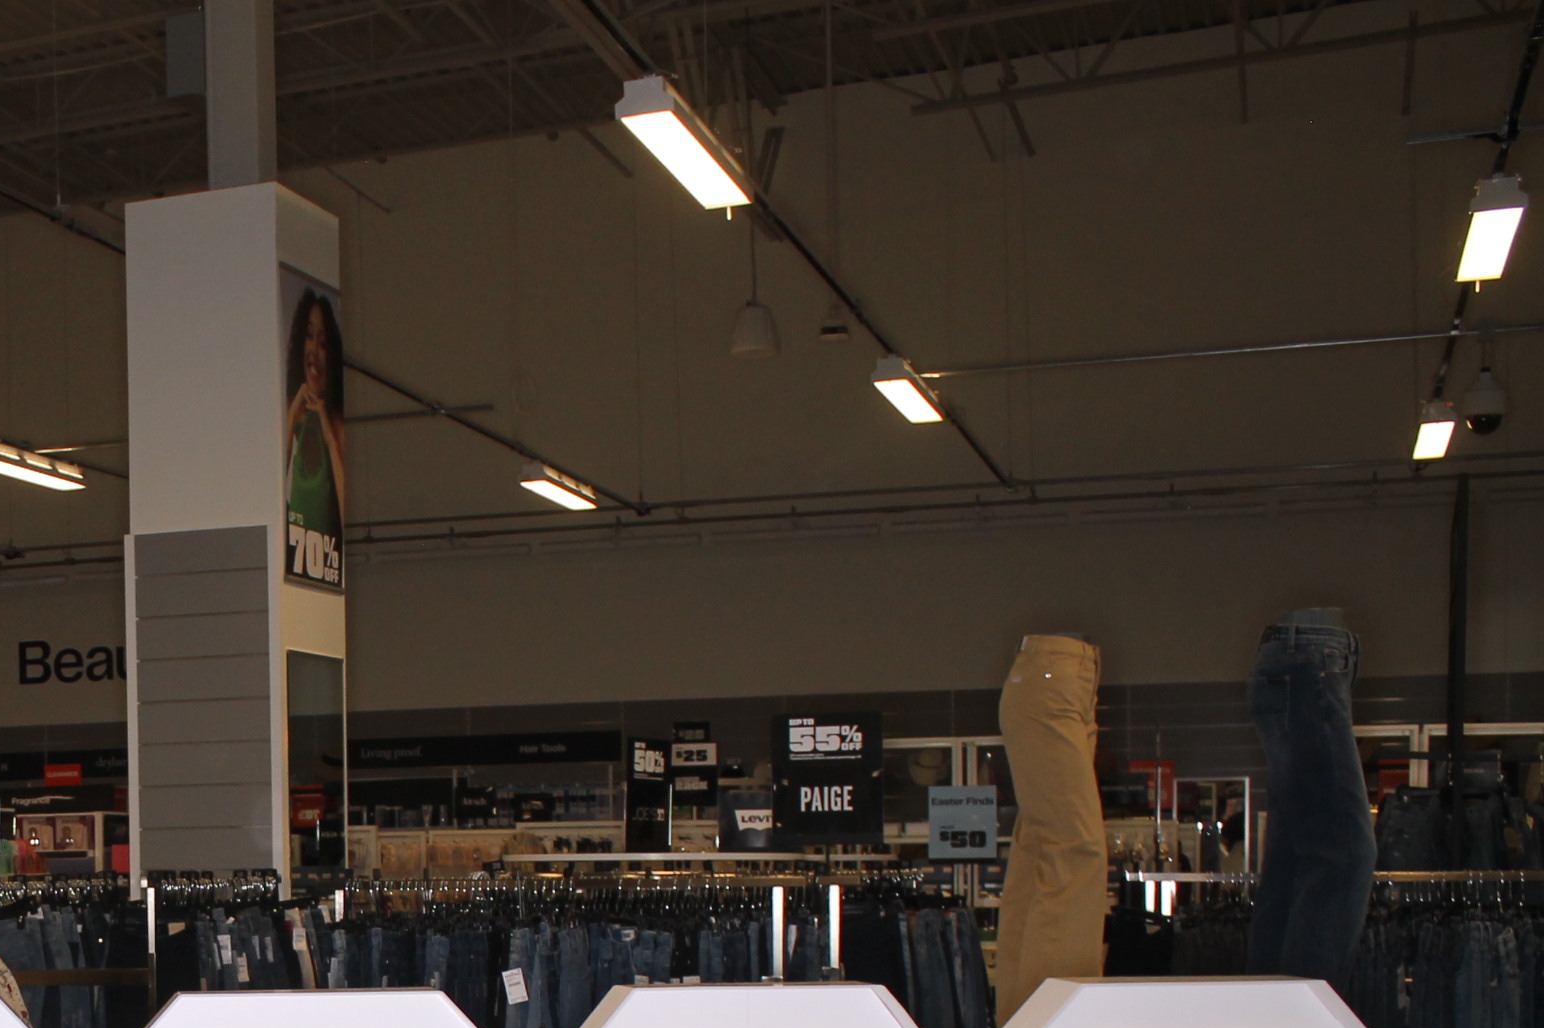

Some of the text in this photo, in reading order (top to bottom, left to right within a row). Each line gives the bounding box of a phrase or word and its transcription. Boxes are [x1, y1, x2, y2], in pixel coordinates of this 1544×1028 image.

[288, 523, 340, 580] 70%
[324, 566, 340, 584] OFF
[788, 725, 863, 753] 55%
[840, 741, 863, 751] OFF
[360, 747, 392, 760] Living
[633, 748, 665, 773] 50%
[675, 749, 708, 762] $25
[799, 785, 854, 813] PAIGE
[939, 830, 987, 849] $50
